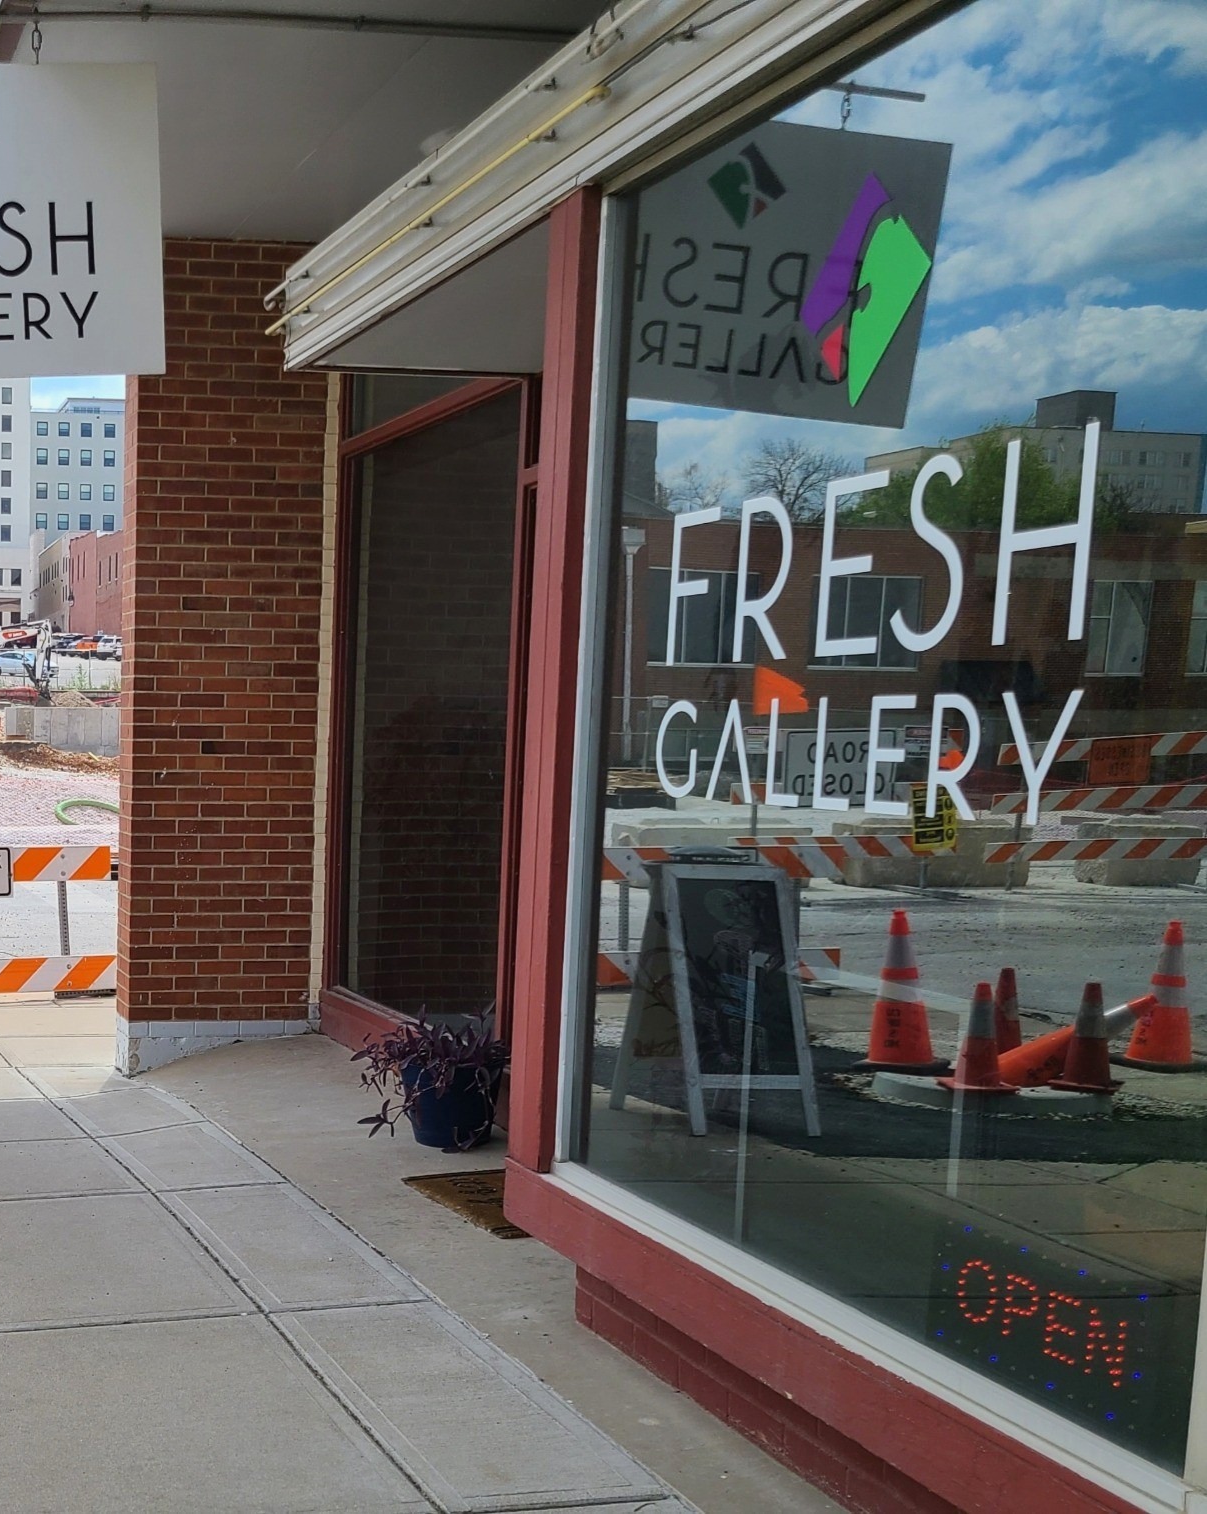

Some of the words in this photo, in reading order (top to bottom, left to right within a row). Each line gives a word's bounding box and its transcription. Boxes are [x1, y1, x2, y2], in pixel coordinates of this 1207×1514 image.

[666, 420, 1100, 667] FRESH
[655, 689, 1085, 826] GALLERY
[957, 1259, 1128, 1389] OPEN
